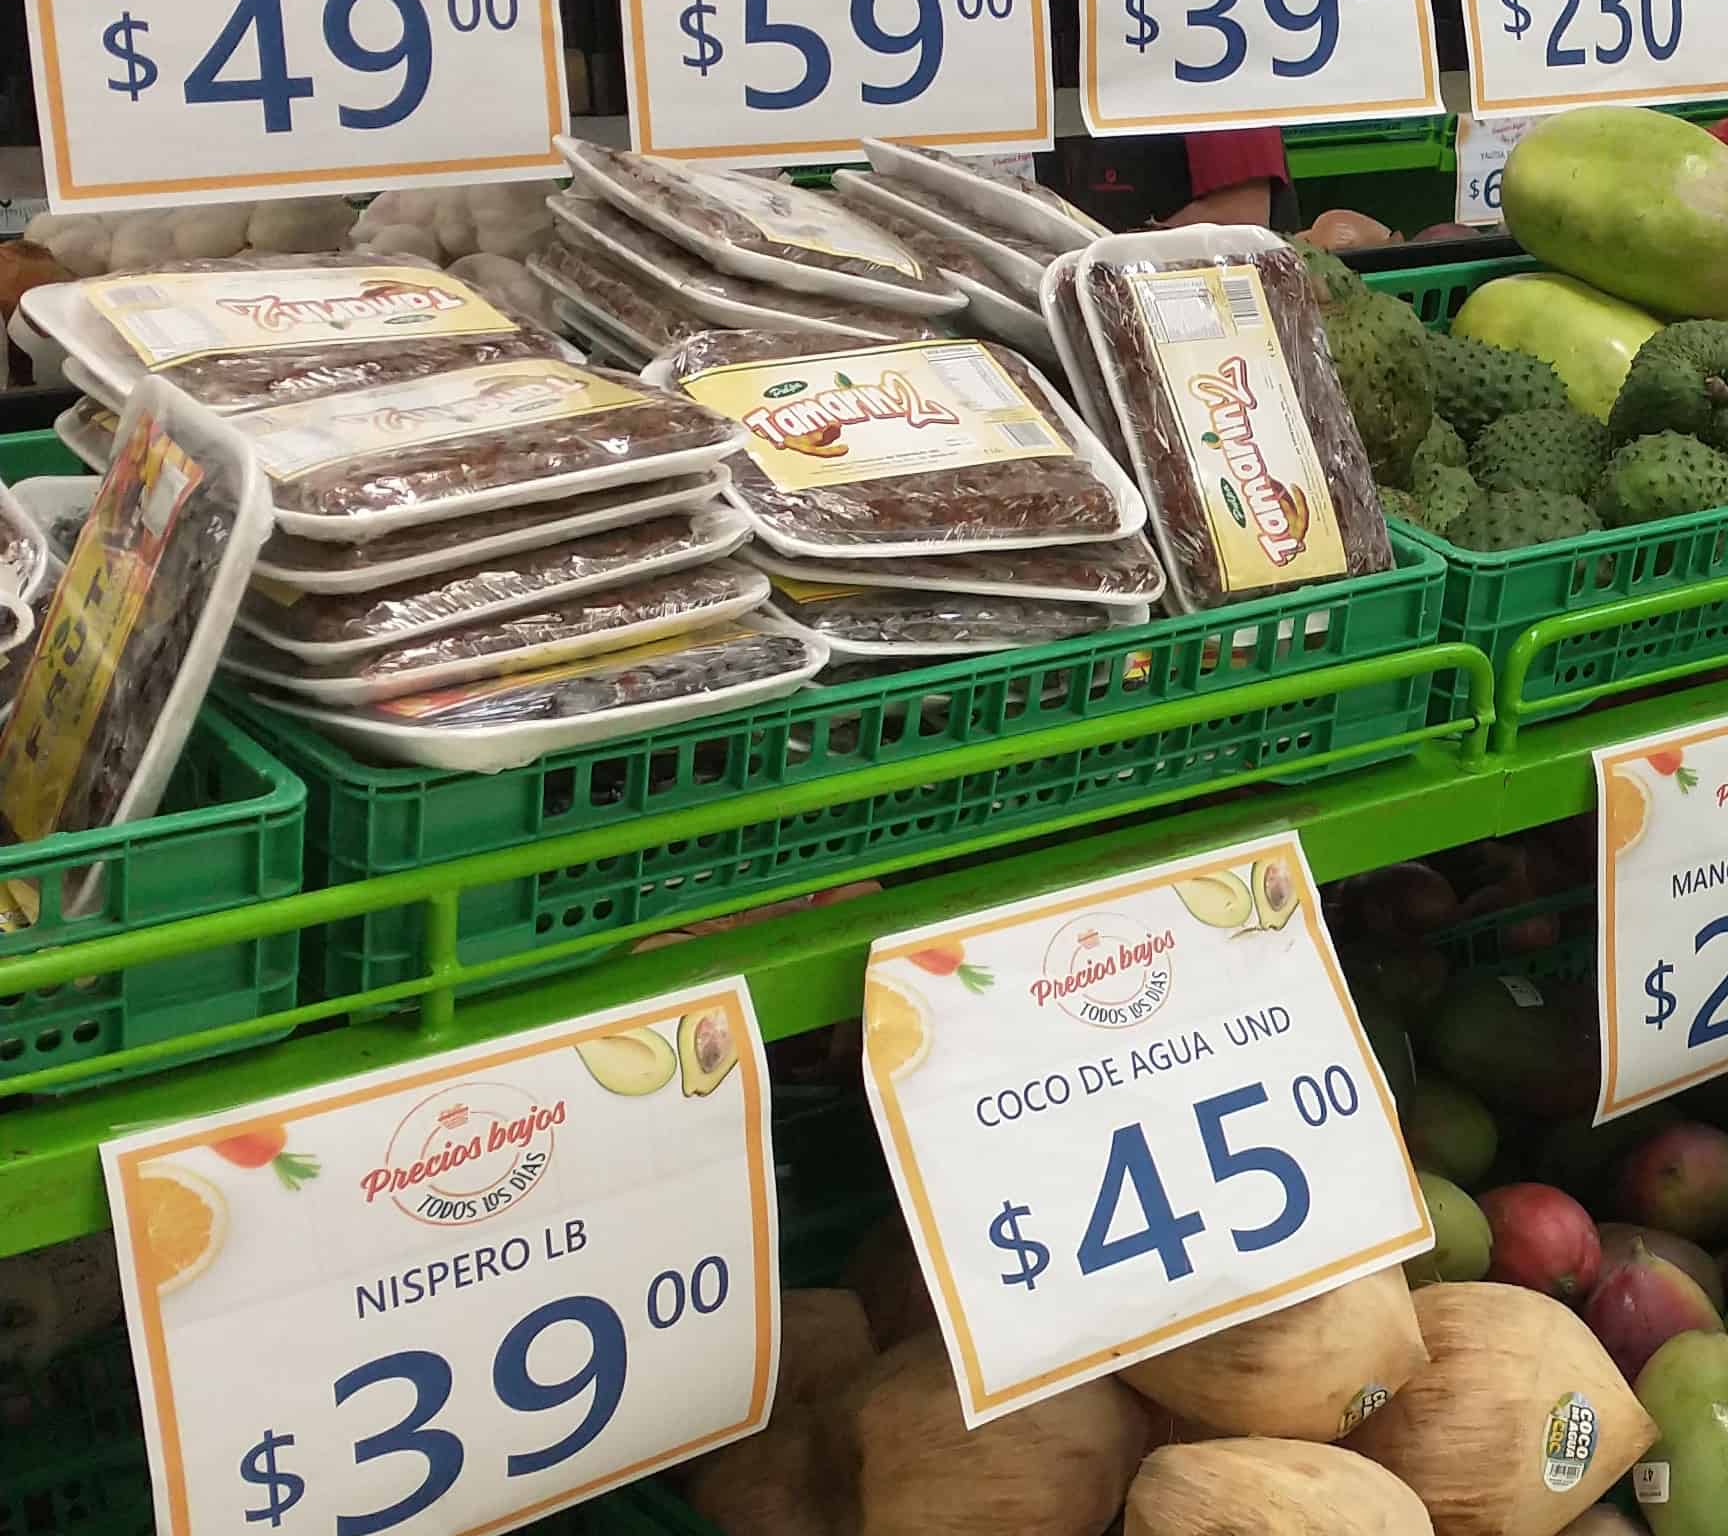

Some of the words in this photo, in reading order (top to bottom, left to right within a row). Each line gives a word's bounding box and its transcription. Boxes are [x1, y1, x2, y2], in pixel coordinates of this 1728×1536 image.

[102, 11, 159, 102] $
[1029, 952, 1117, 1007] Precios
[1119, 928, 1176, 970] bajos
[1644, 959, 1677, 1031] $
[976, 1075, 1071, 1128] COCO
[1078, 1057, 1124, 1096] DE
[1130, 1030, 1215, 1080] AGUA
[1223, 1004, 1292, 1048] UND
[359, 1132, 483, 1204] Precios
[486, 1097, 566, 1154] bajos
[988, 1199, 1051, 1292] $
[1076, 1081, 1311, 1283] 45
[1291, 1064, 1360, 1127] 00
[416, 1192, 478, 1221] TODOS
[355, 1237, 531, 1320] NISPERO
[543, 1218, 588, 1262] LB
[239, 1429, 306, 1529] $
[646, 1254, 730, 1330] 00
[1575, 1407, 1594, 1460] COCO
[1565, 1421, 1579, 1459] AGUA
